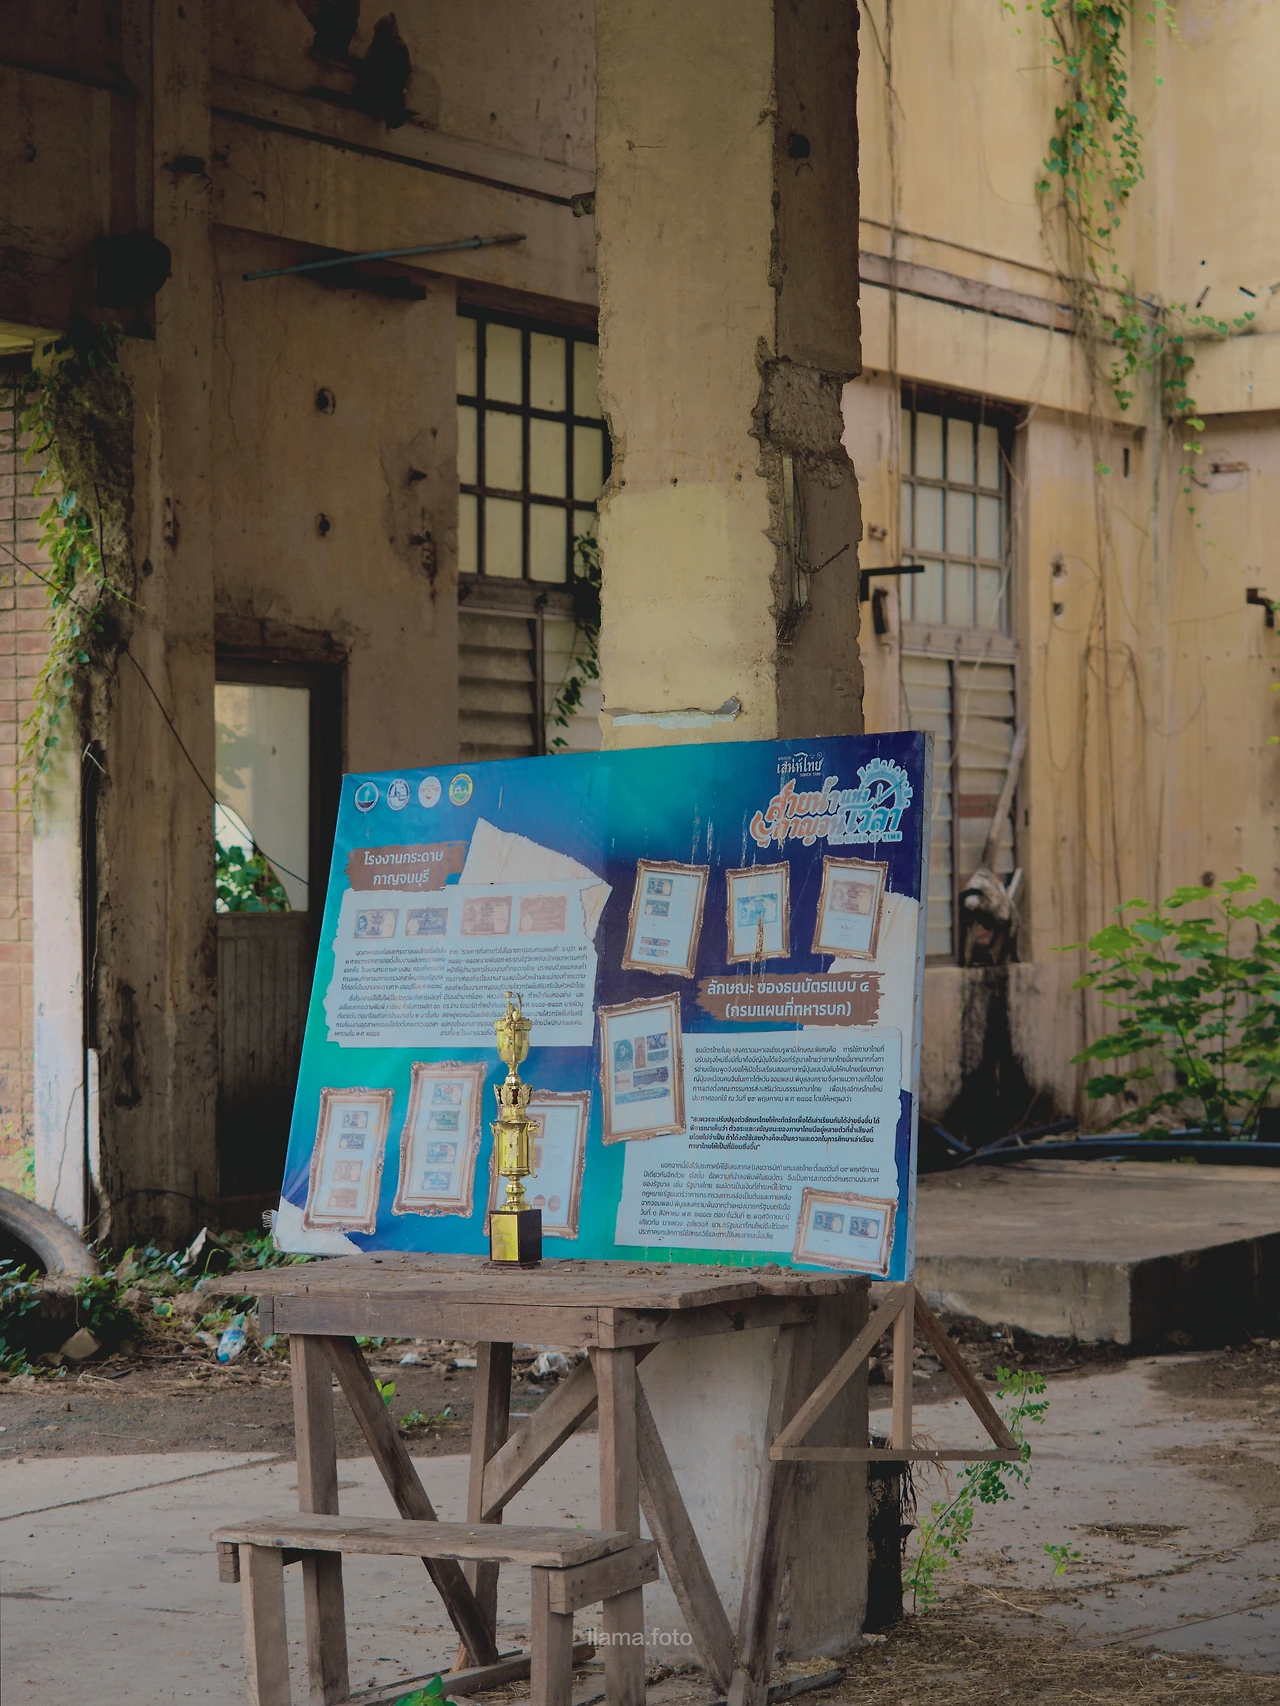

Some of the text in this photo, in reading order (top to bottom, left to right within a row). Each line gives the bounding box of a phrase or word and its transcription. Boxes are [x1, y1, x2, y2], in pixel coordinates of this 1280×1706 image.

[777, 752, 824, 774] เสน่ห์ไทย
[845, 834, 868, 842] RIVER
[364, 851, 444, 865] โรงงานกระดาษ
[373, 869, 430, 887] กาญจนบุรี
[707, 978, 870, 995] ลักษณะ ของธนบัตรแบบ ๔
[725, 997, 852, 1018] (กรมแผนที่ทหารบก)
